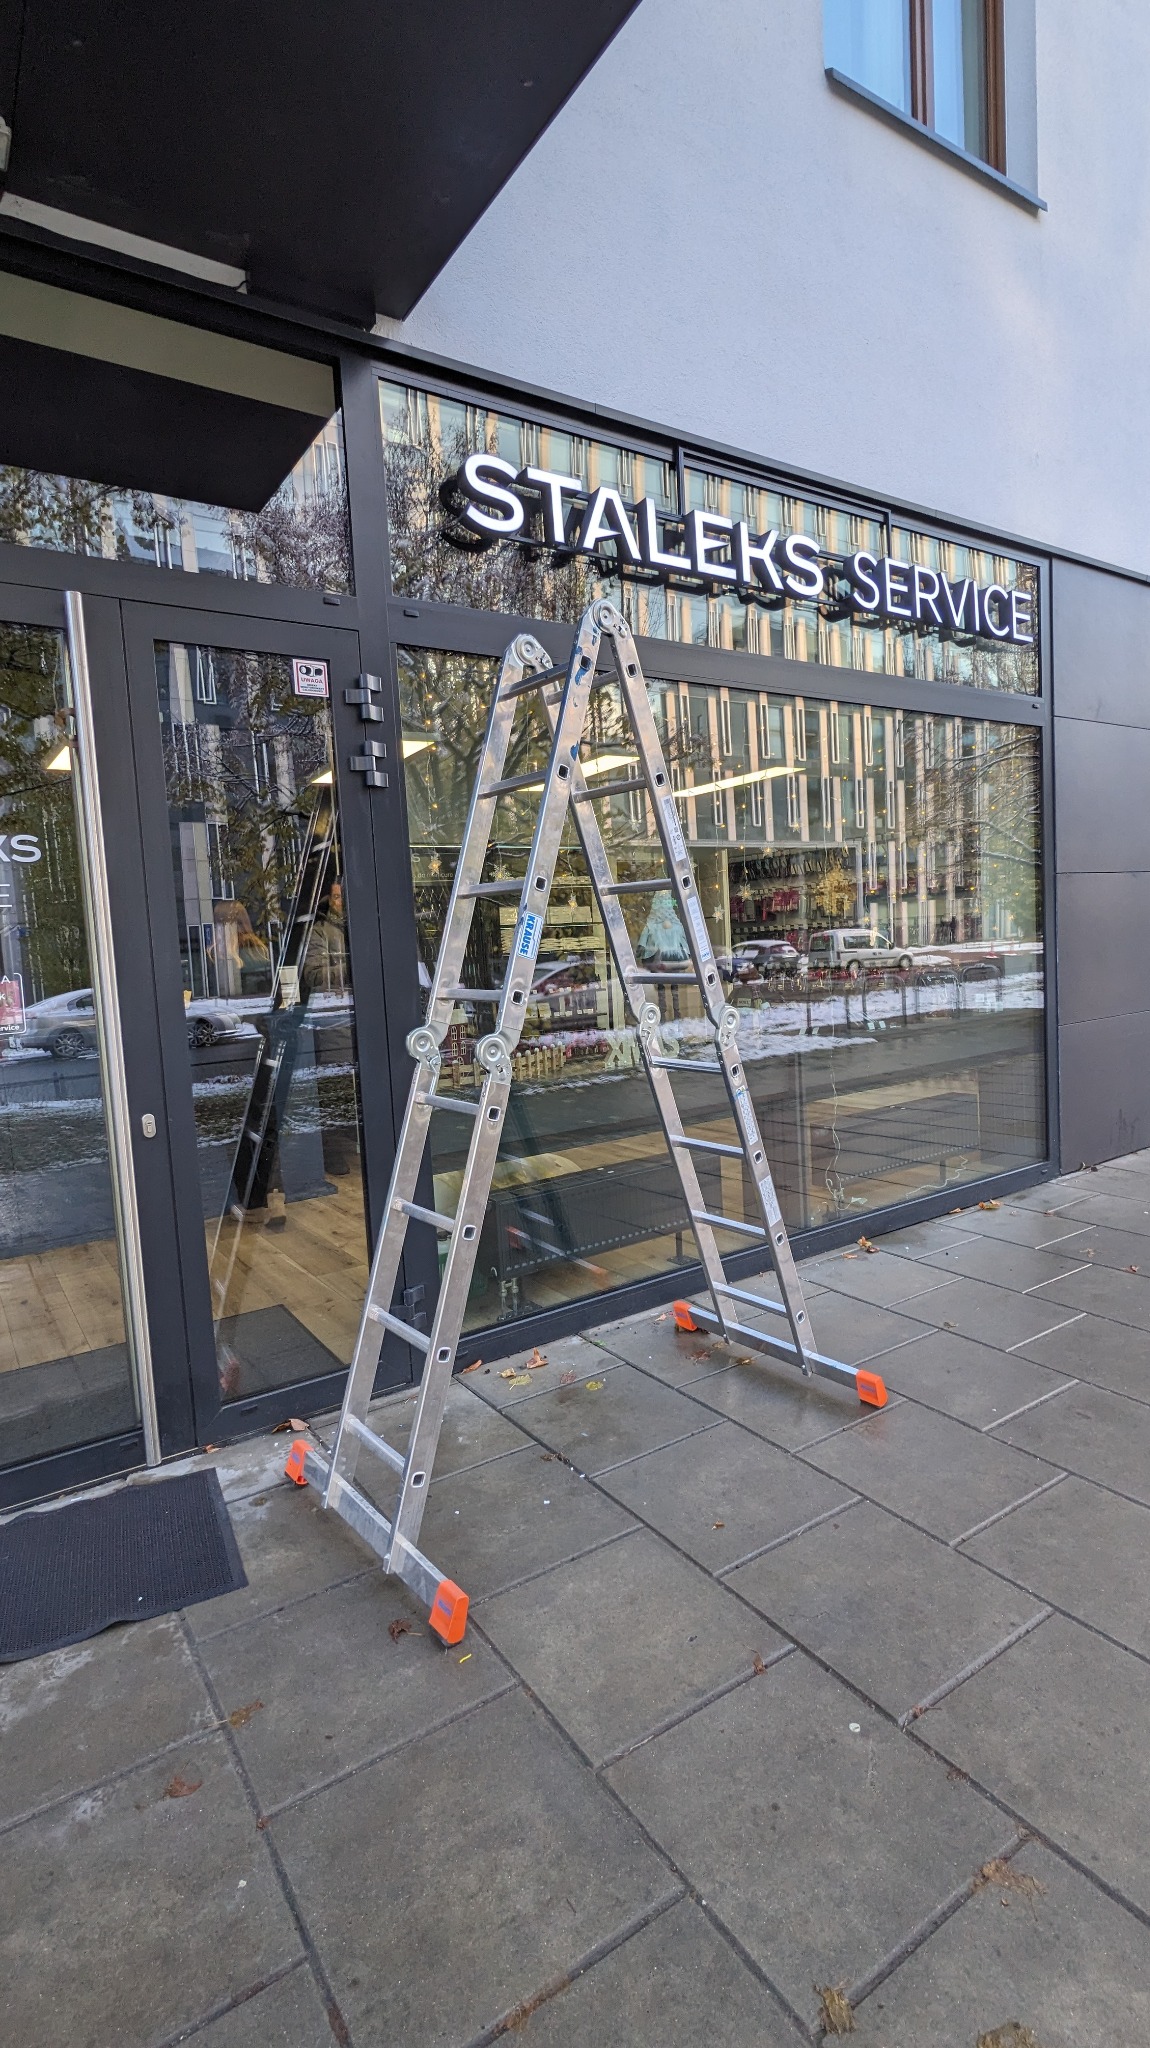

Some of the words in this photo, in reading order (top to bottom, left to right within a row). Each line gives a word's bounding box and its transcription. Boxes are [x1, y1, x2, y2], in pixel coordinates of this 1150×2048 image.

[462, 452, 825, 598] STALEKS
[852, 550, 1034, 644] SERVICE
[519, 914, 536, 955] KRAUSE
